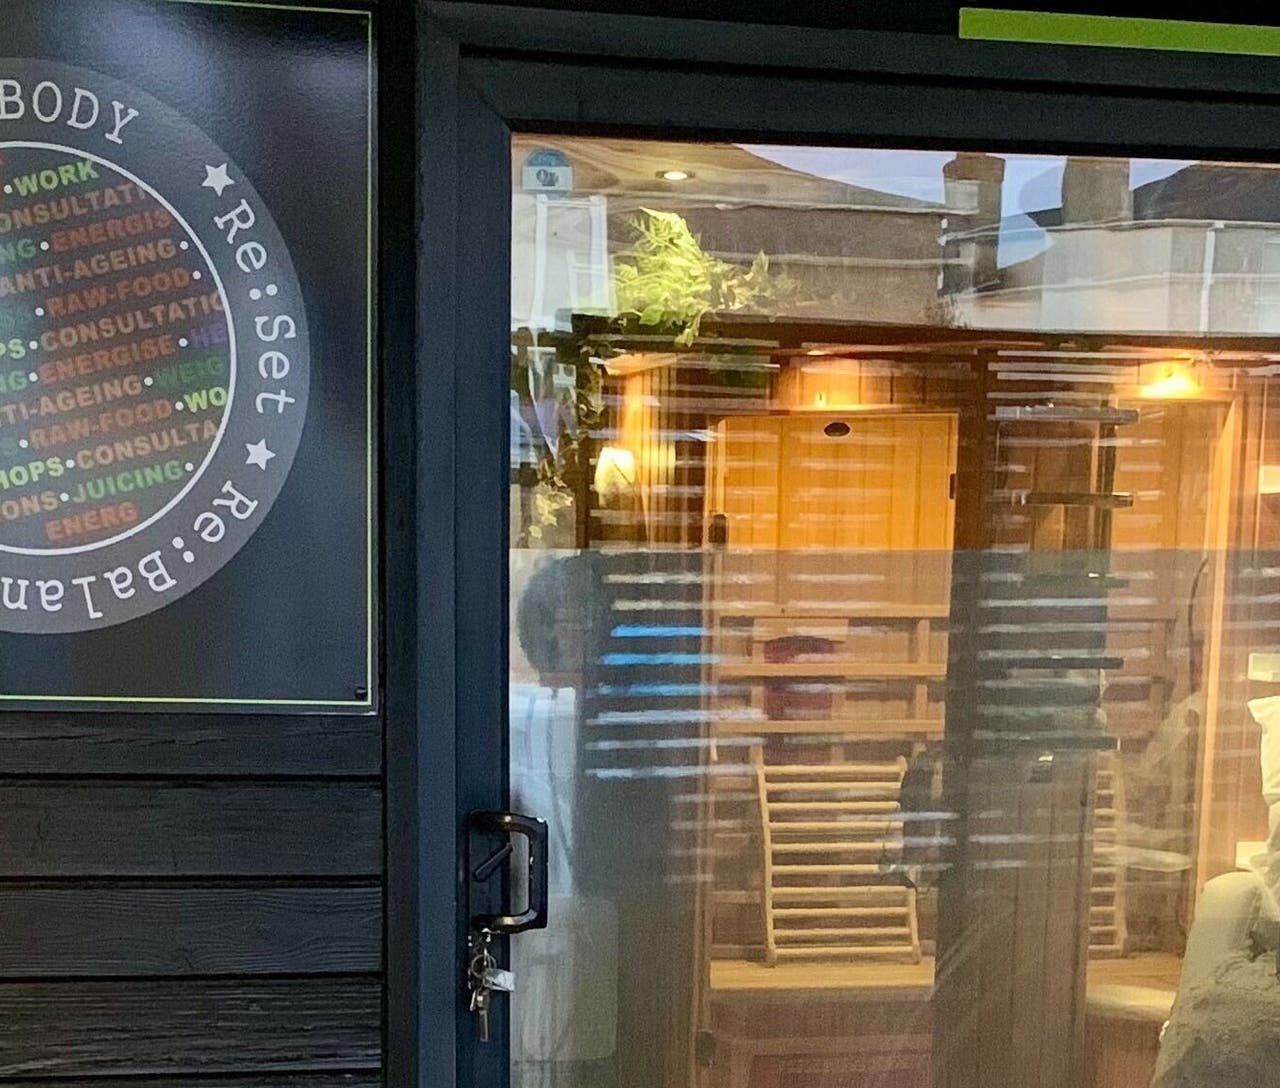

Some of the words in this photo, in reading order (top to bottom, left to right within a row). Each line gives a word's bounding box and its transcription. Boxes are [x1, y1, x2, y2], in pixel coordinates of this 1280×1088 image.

[13, 160, 100, 197] WORK
[214, 199, 296, 415] Re:Set
[183, 387, 227, 413] WO
[72, 459, 183, 503] JUICING
[46, 501, 139, 541] ENERG
